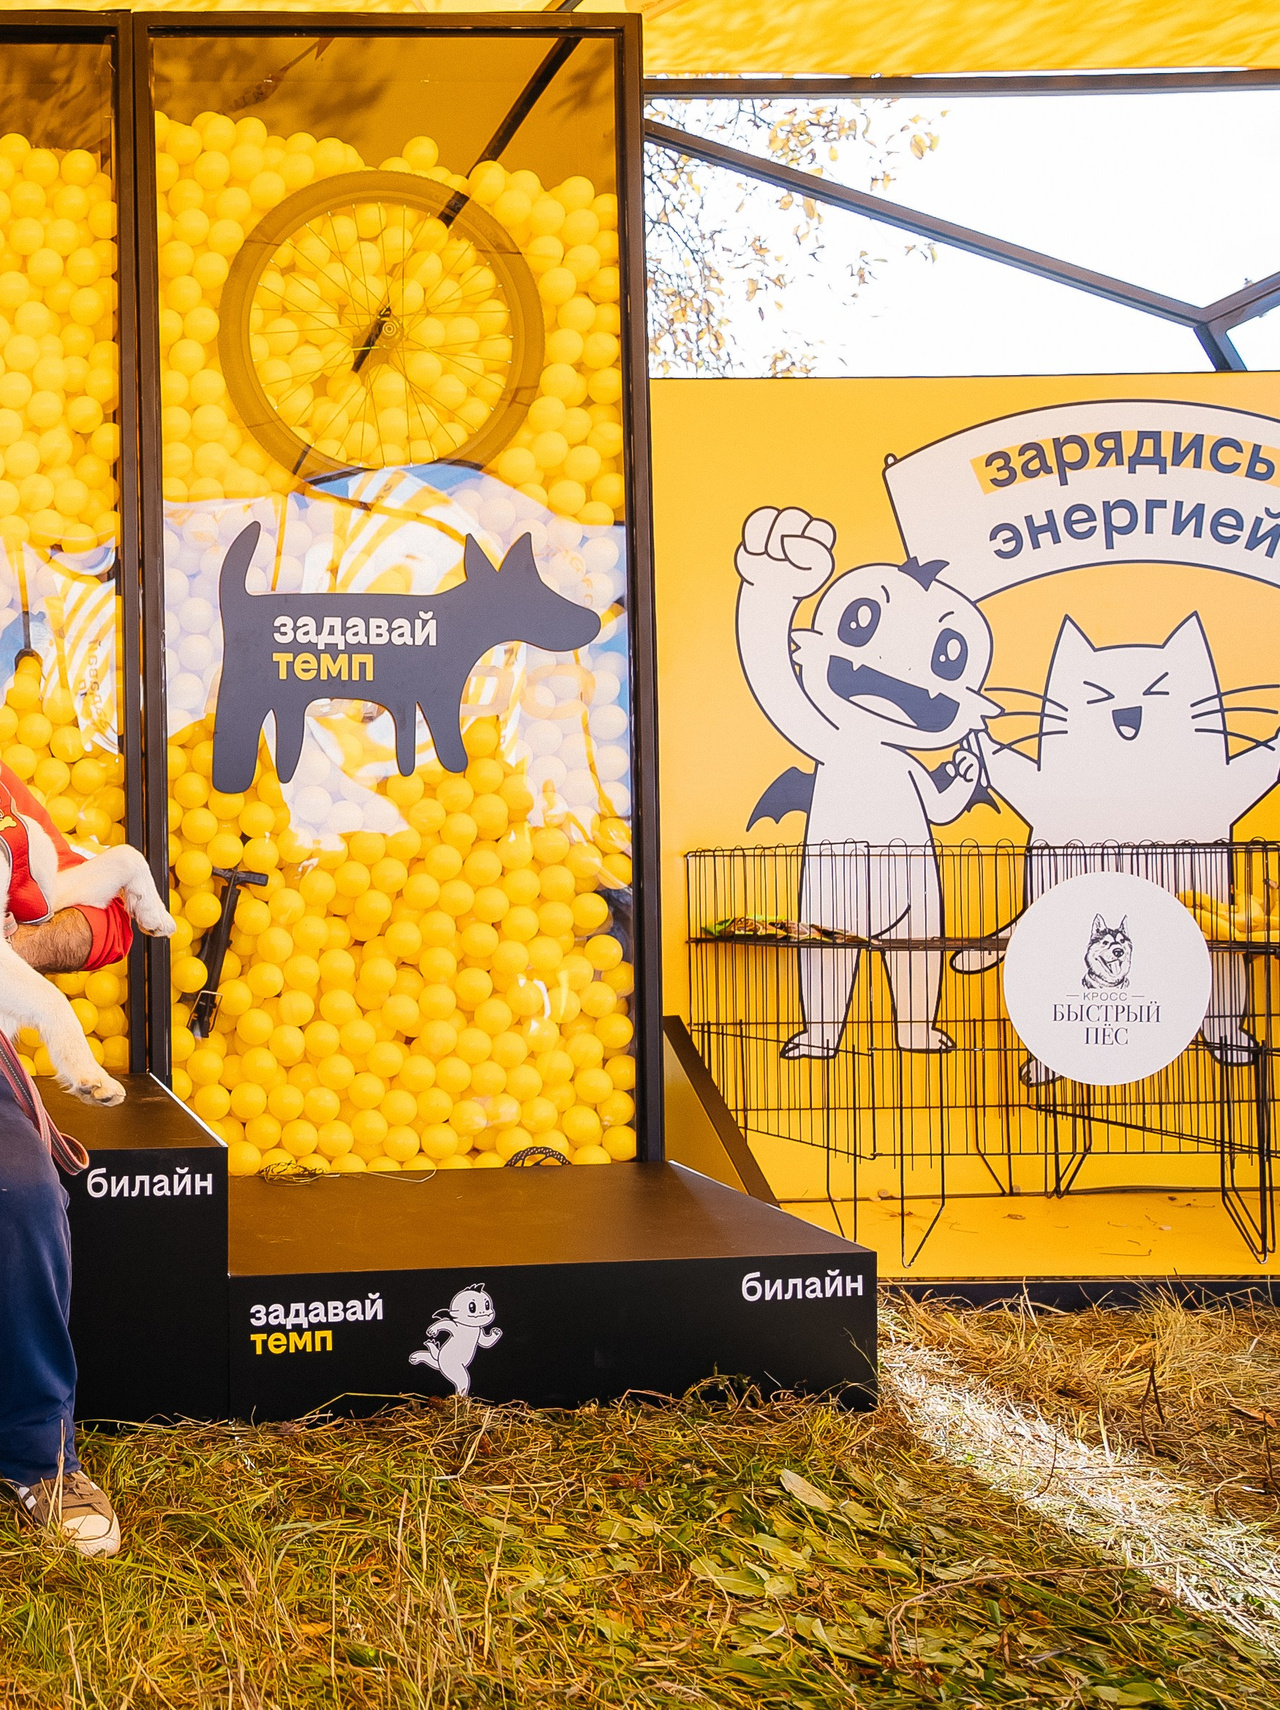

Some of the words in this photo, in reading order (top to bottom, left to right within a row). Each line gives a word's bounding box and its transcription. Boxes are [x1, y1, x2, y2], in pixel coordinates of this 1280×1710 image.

[984, 430, 1277, 488] зарядись
[988, 498, 1280, 560] энергией
[272, 610, 438, 651] задавай
[271, 651, 375, 682] темп
[1052, 1000, 1162, 1024] БЫСТРЫЙ
[1082, 991, 1129, 1002] КРОСС
[1084, 1022, 1130, 1046] ПЁС
[86, 1166, 214, 1198] билайн
[741, 1268, 864, 1302] билайн
[249, 1292, 384, 1330] задавай
[249, 1329, 333, 1356] темп
